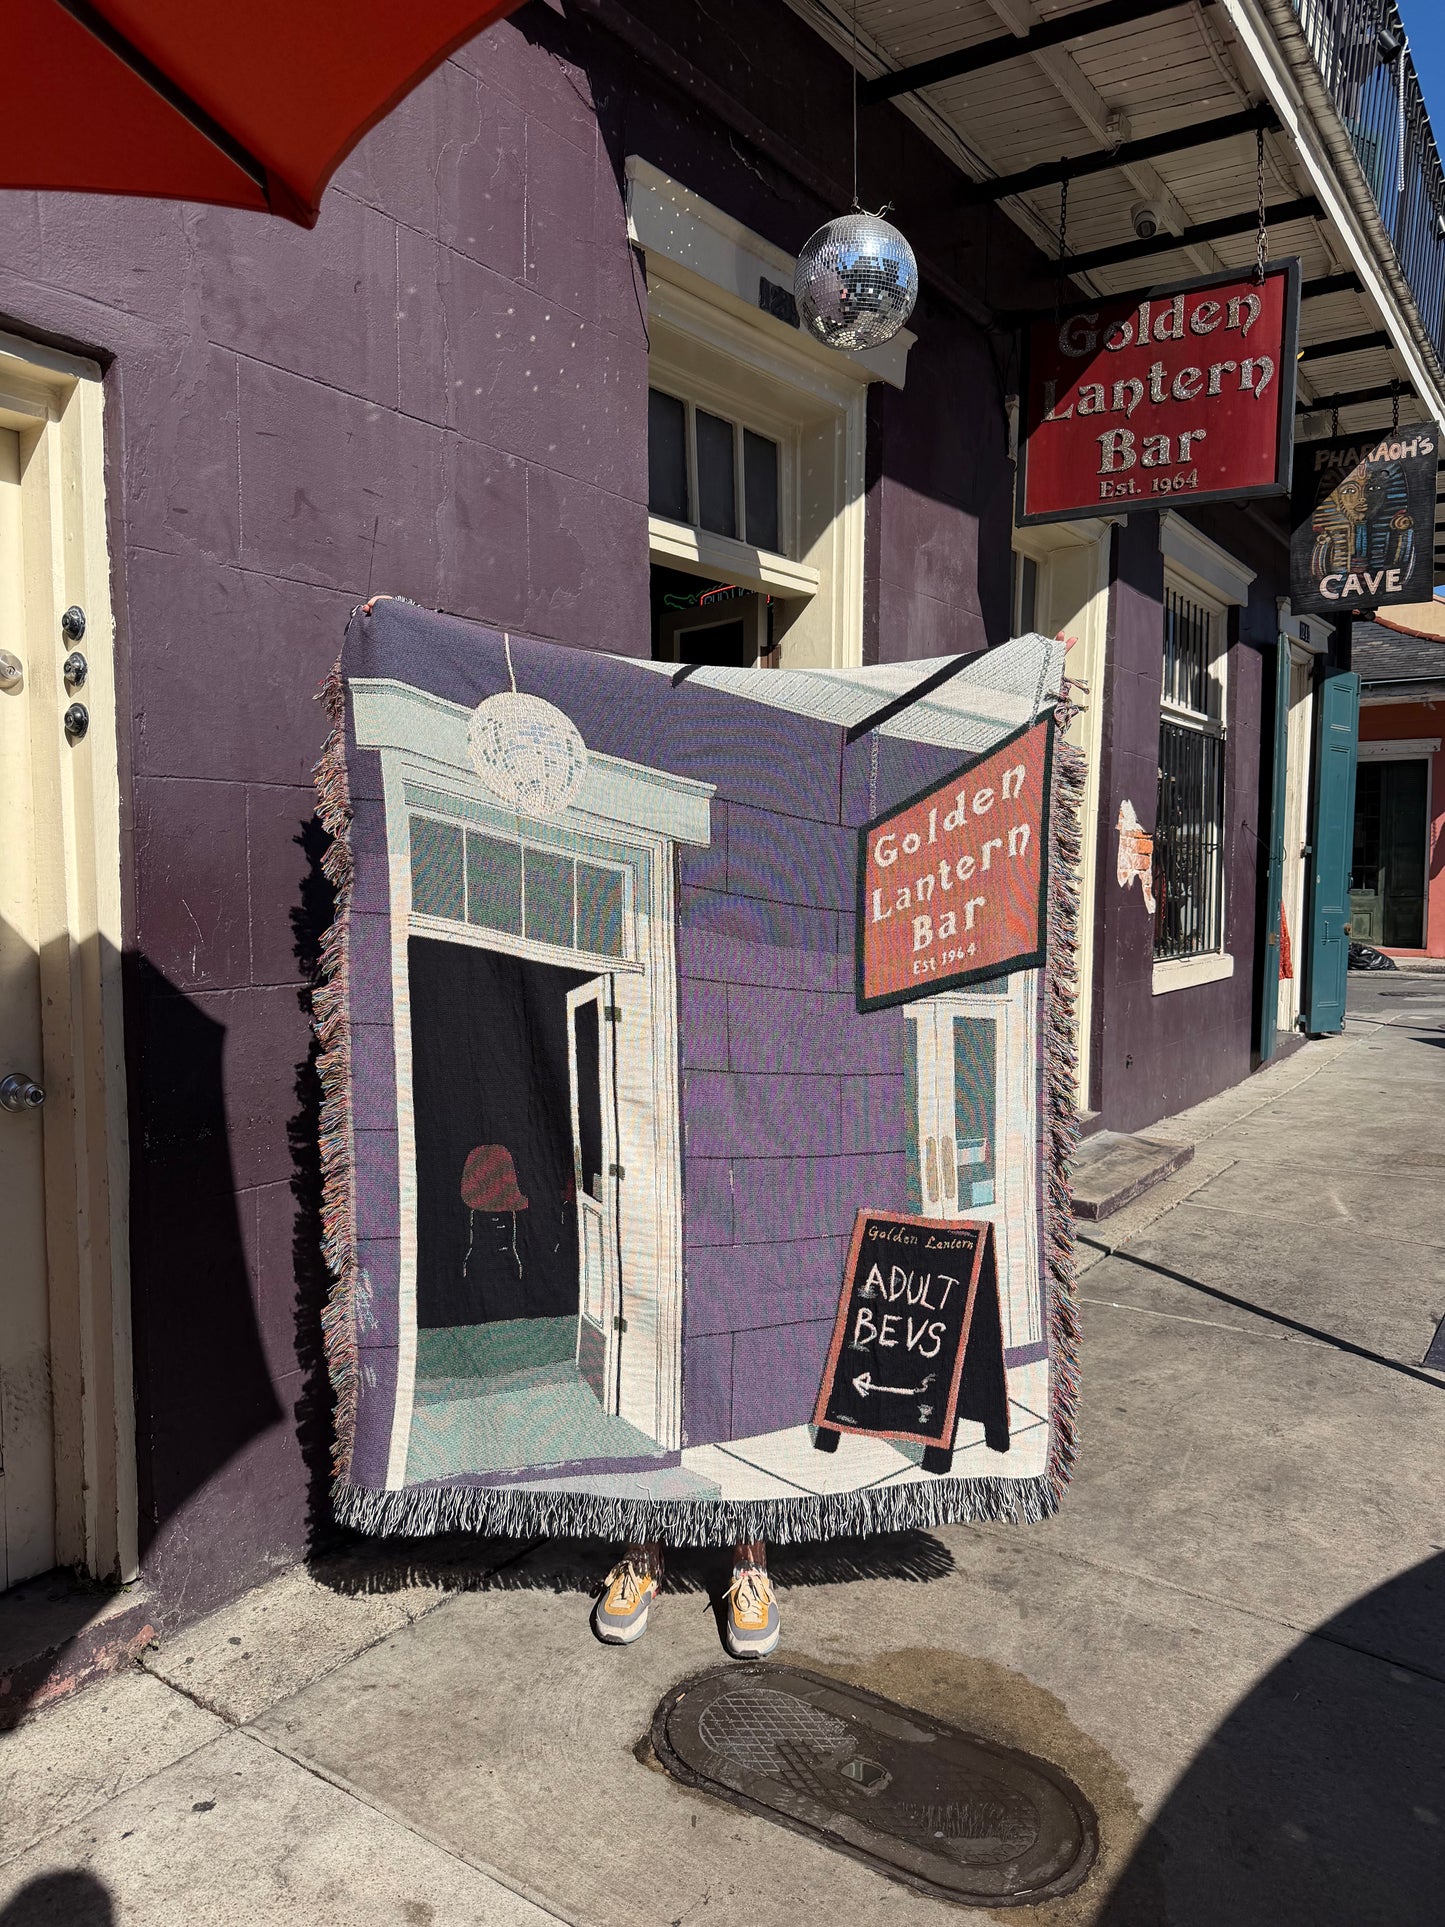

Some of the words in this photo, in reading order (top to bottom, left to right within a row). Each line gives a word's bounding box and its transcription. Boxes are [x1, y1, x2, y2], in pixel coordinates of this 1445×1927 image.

[1058, 293, 1262, 358] Golden
[1041, 355, 1275, 423] Lantern
[1096, 428, 1207, 476] Bar
[1314, 435, 1434, 471] PHARAOH'S
[1100, 480, 1142, 499] Est.
[1151, 468, 1199, 496] 1964
[1319, 569, 1403, 600] CAVE
[873, 763, 1026, 868] Golden
[871, 823, 1031, 923] Lantern
[911, 896, 987, 952] Bar
[941, 942, 977, 965] 1964
[865, 1263, 960, 1311] ADULT
[854, 1307, 947, 1358] BEVS
